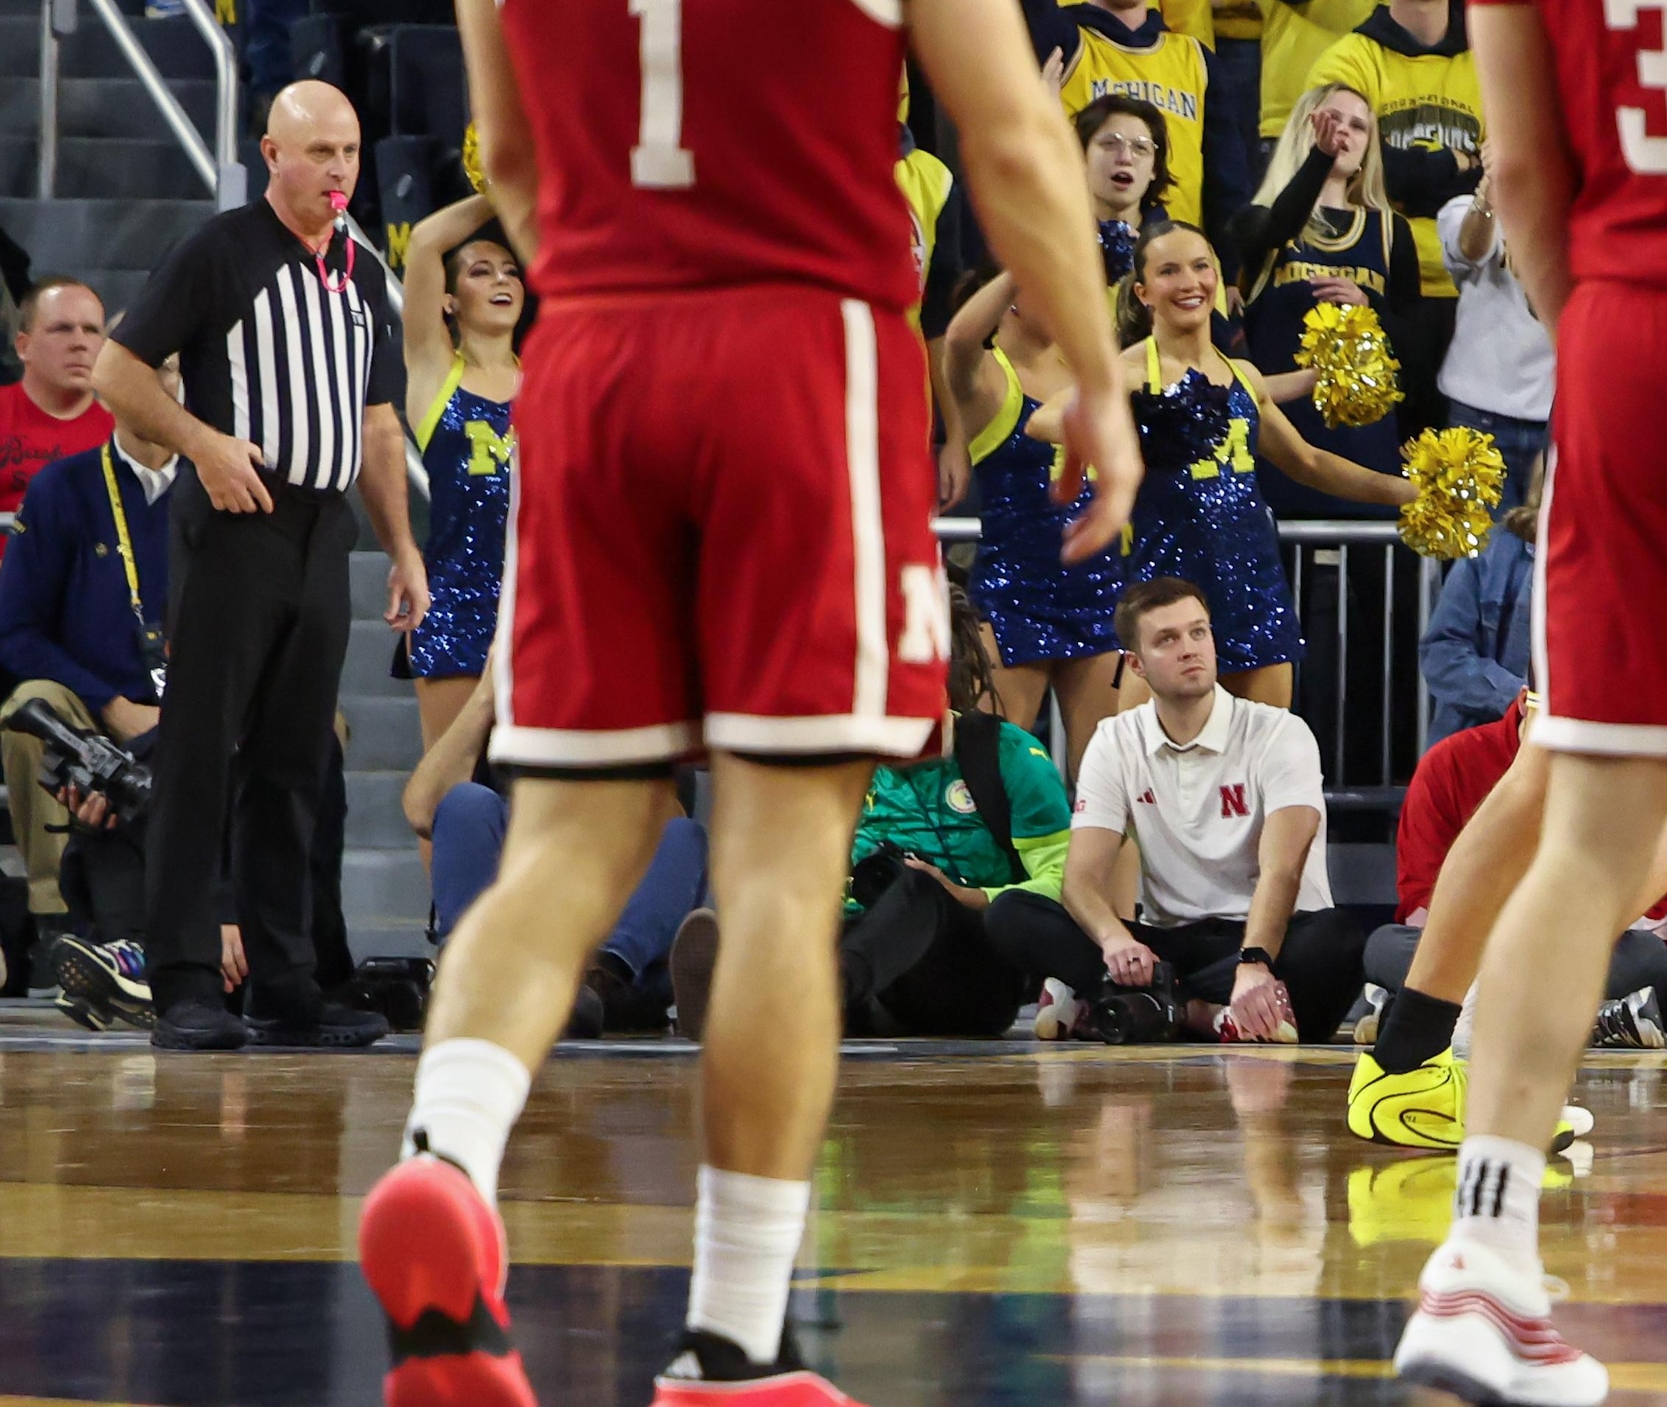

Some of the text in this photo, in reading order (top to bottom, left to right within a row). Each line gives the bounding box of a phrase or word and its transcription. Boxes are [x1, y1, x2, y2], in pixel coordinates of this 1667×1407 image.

[1090, 77, 1198, 122] MHIGAN
[386, 220, 413, 268] M
[1273, 263, 1387, 296] MICHIGAN
[463, 419, 515, 476] M
[897, 561, 951, 666] N
[1219, 783, 1251, 820] N
